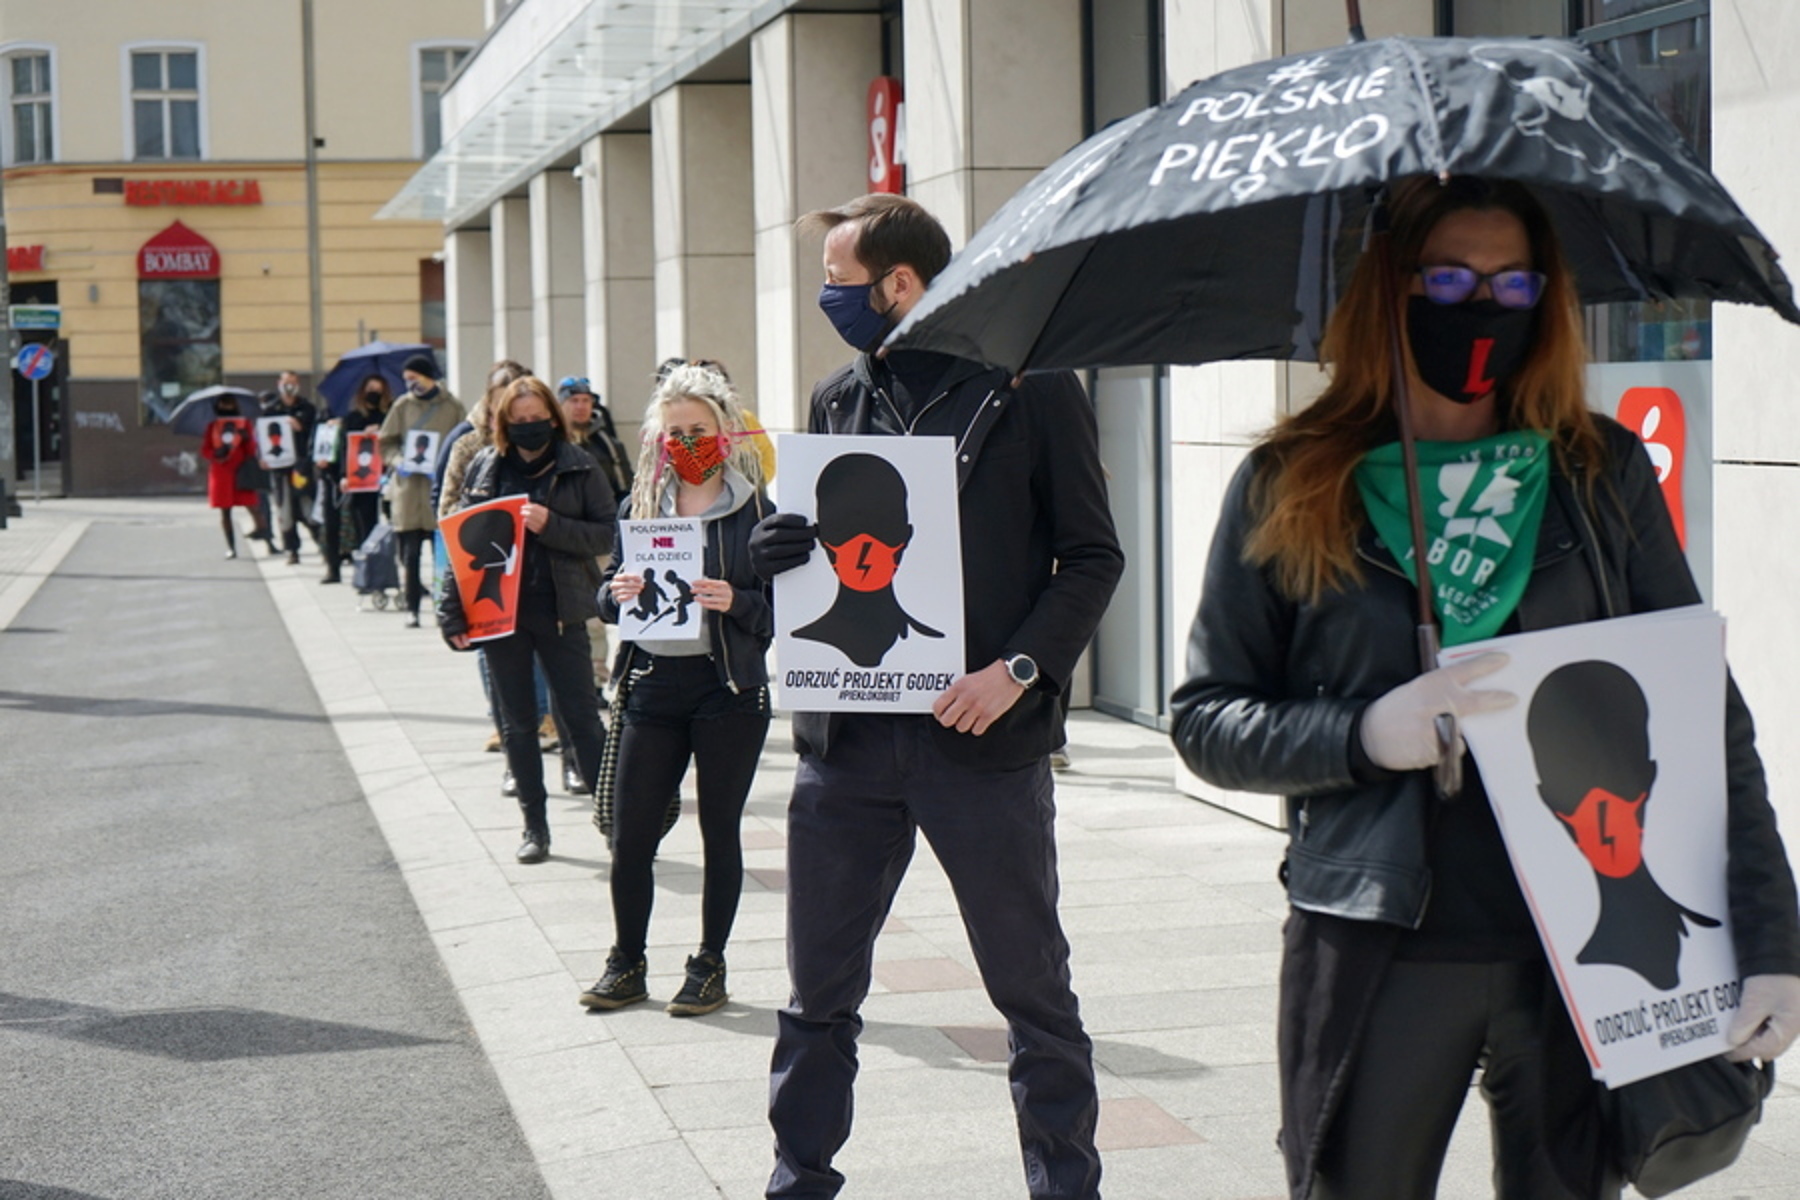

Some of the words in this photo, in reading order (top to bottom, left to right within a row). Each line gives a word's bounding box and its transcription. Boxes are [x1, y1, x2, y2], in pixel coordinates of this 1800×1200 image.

[1178, 66, 1393, 126] POLSKIE
[1149, 113, 1389, 186] PIEKŁO
[144, 252, 212, 272] BOMBAY
[629, 523, 694, 534] POLOWANIA
[652, 537, 674, 548] NIE
[635, 553, 655, 562] DLA
[657, 551, 693, 561] DZIECI
[785, 667, 841, 689] ODRZUĆ
[843, 671, 905, 690] PROJEKT
[906, 673, 955, 691] GODEK
[1595, 1000, 1652, 1045] ODRZUĆ
[1652, 988, 1713, 1030] PROJEKT
